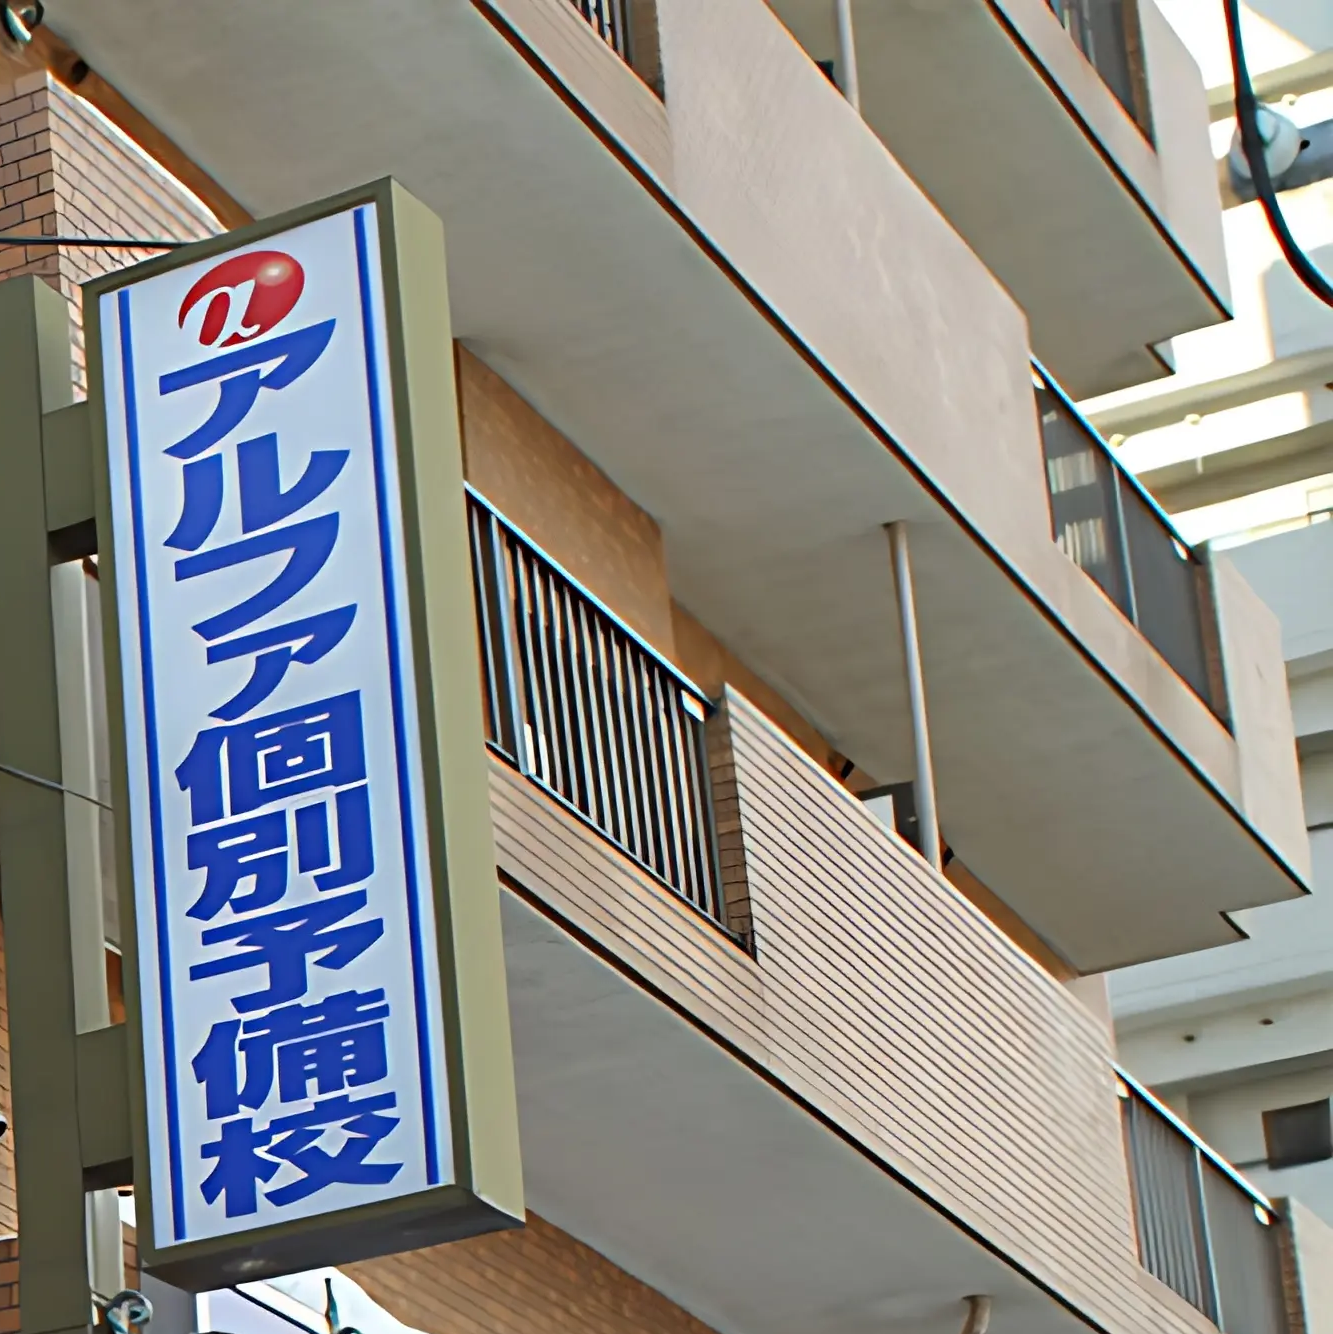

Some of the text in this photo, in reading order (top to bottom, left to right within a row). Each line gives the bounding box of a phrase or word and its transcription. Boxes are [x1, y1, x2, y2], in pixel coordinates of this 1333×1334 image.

[159, 318, 404, 1218] アルファ個別予備校
